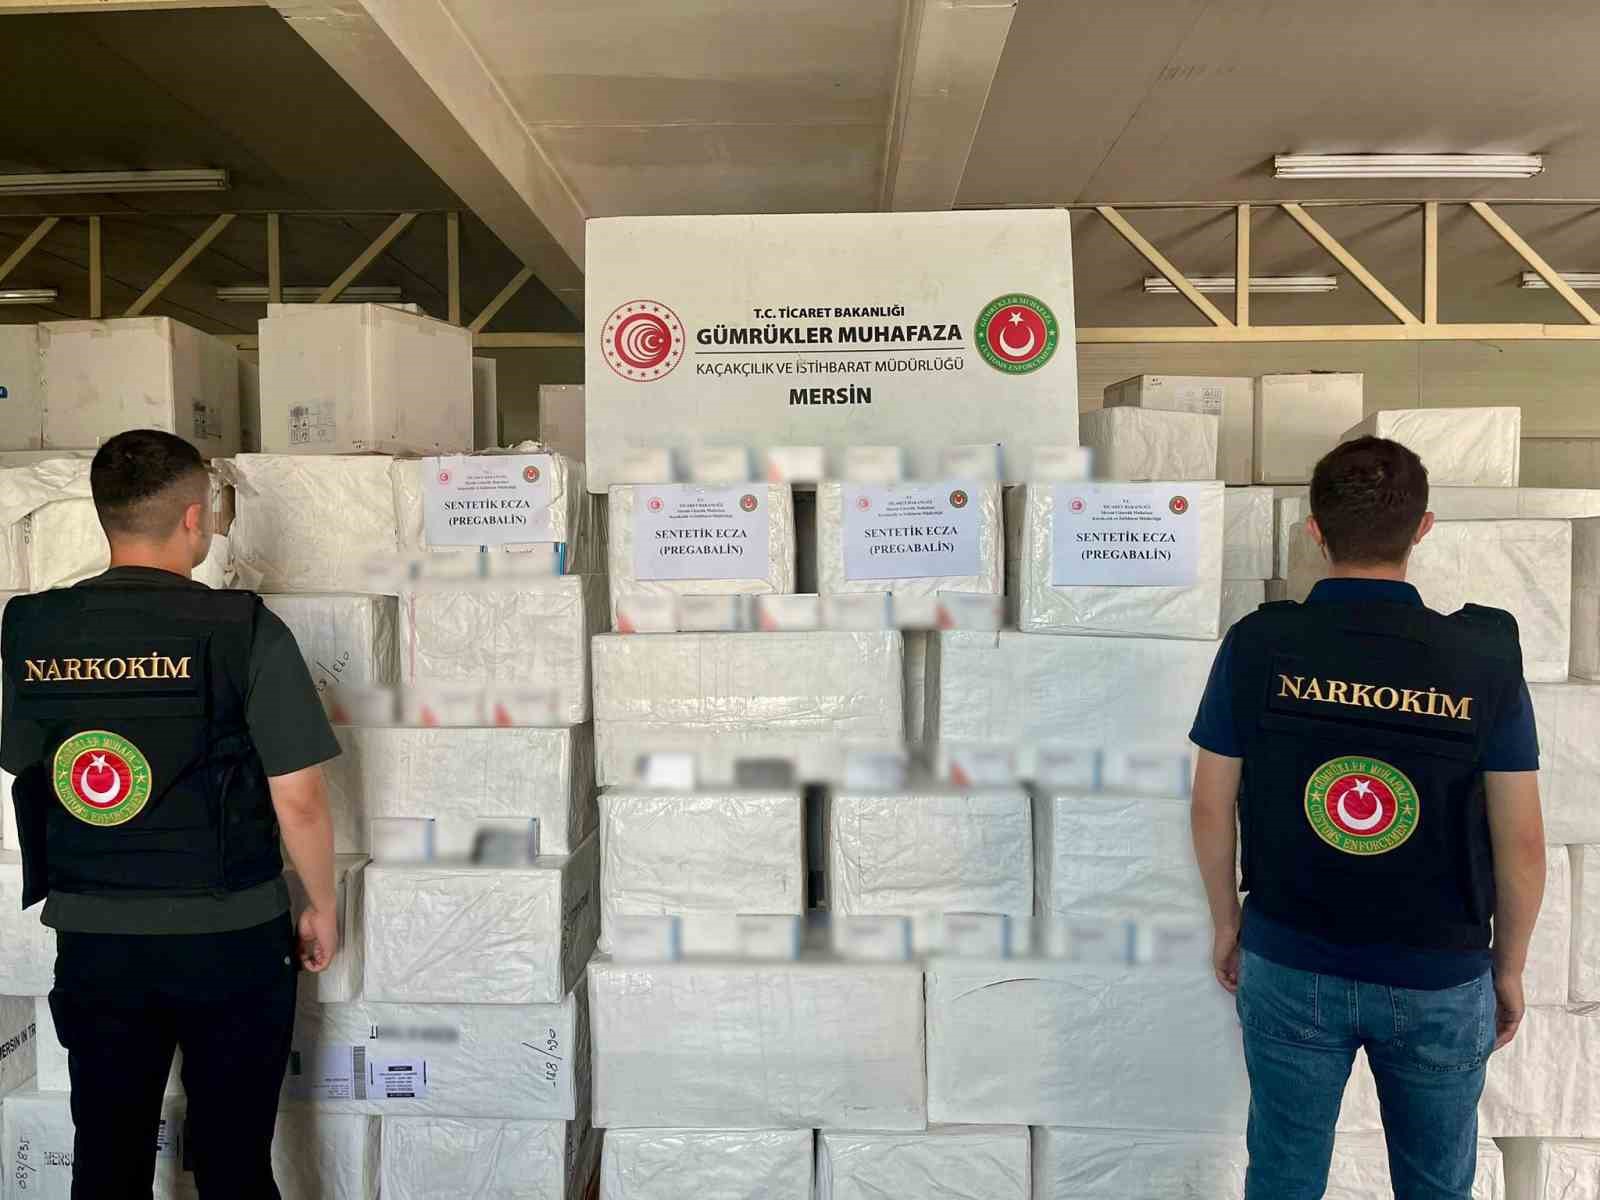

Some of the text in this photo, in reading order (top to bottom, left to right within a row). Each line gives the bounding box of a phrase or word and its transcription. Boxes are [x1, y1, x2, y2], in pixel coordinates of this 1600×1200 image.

[753, 304, 905, 318] T.C. TİCARET BAKANLIĞI
[696, 323, 963, 344] GÜMRÜKLER MUHAFAZA
[696, 356, 964, 377] KAÇAKÇILIK VE İSTİHBARAT MÜDÜRLÜĞÜ
[789, 384, 872, 405] MERSİN
[444, 498, 531, 510] SENTETİK ECZA
[449, 514, 526, 527] (PREGABALİN)
[655, 528, 748, 539] SENTETİK ECZA
[864, 525, 959, 538] SENTETİK ECZA
[1076, 530, 1176, 542] SENTETİK ECZA
[659, 543, 744, 556] (PREGABALİN)
[869, 541, 954, 555] (PREGABALİN)
[1081, 548, 1171, 560] (PREGABALİN)
[24, 651, 192, 681] NARKOKİM
[1277, 674, 1473, 720] NARKOKİM
[0, 1034, 20, 1060] ERSIN
